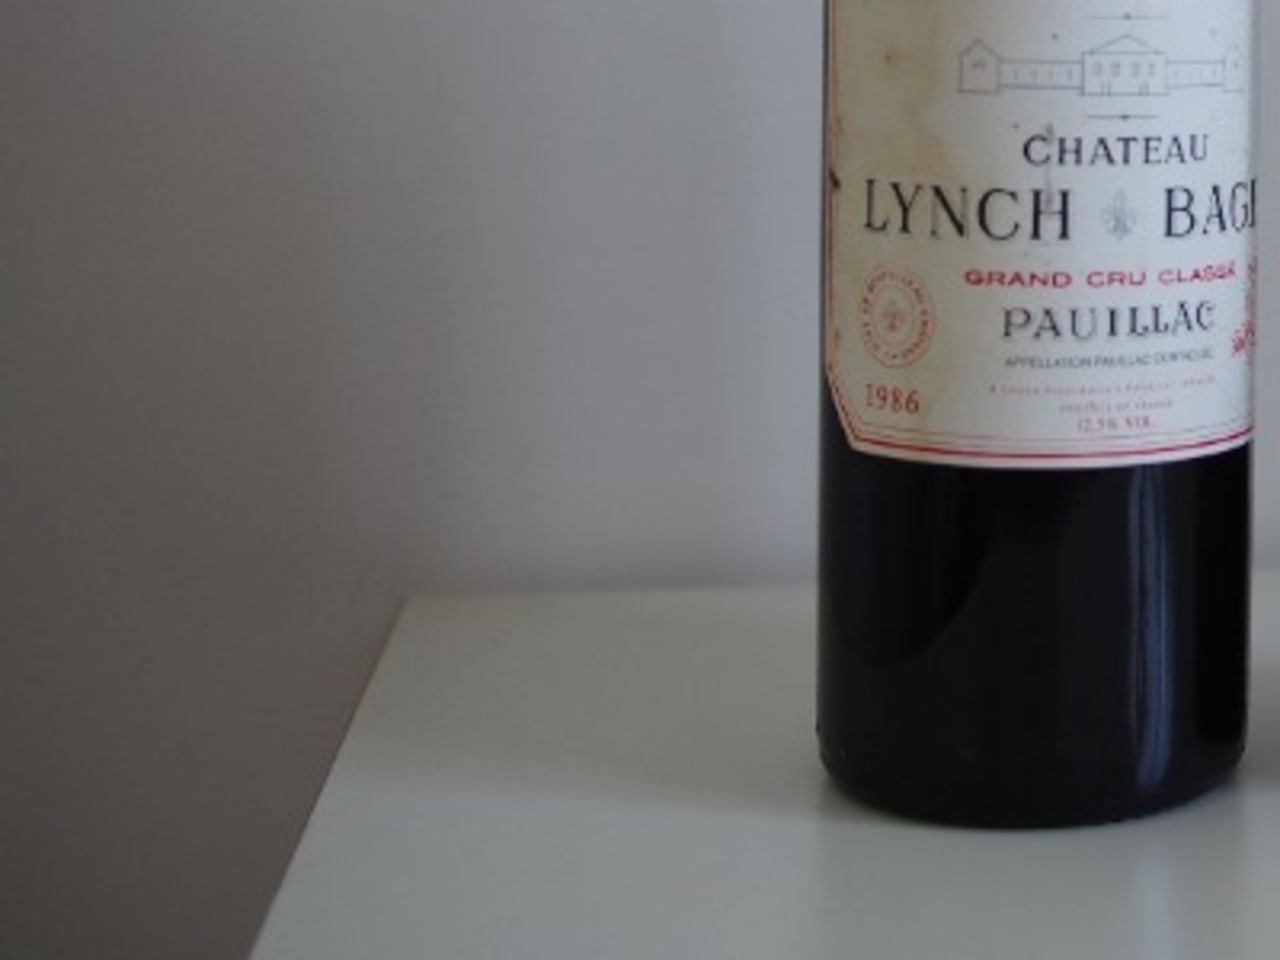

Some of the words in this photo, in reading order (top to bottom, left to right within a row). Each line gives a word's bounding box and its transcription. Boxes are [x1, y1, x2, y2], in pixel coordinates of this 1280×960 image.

[1022, 134, 1209, 167] CHATEAU
[864, 178, 1071, 241] LYNCH
[964, 268, 1073, 289] GRAND
[1086, 269, 1148, 289] CRU
[1001, 300, 1215, 340] PAUILLAC
[865, 382, 920, 414] 1986
